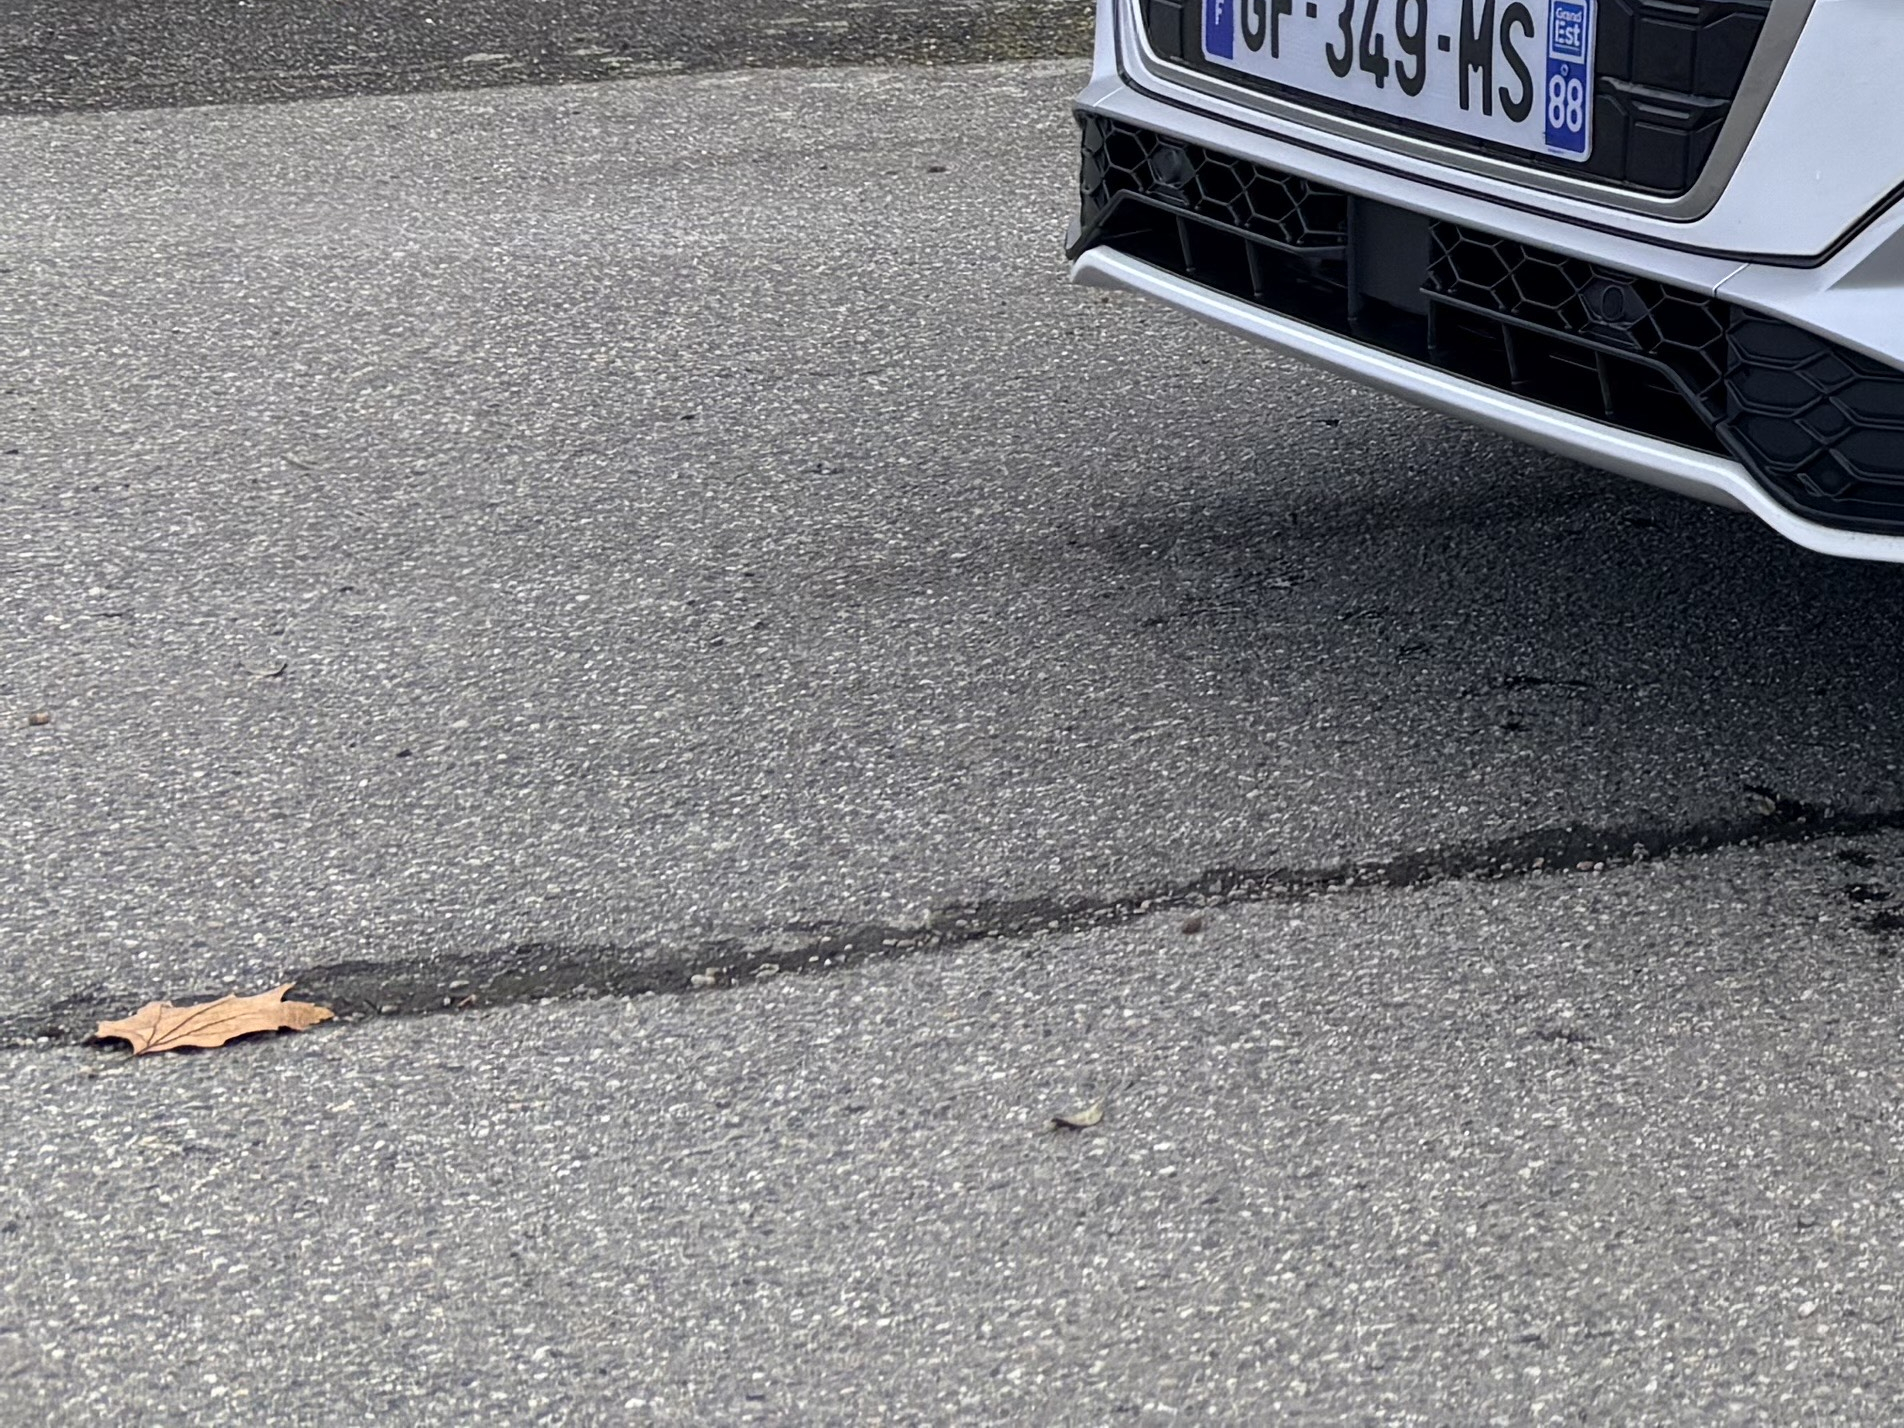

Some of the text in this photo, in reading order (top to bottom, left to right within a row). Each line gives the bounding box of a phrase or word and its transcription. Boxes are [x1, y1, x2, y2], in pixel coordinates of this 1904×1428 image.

[1555, 7, 1582, 23] Grand
[1555, 19, 1581, 46] Est
[1549, 74, 1583, 133] 88
